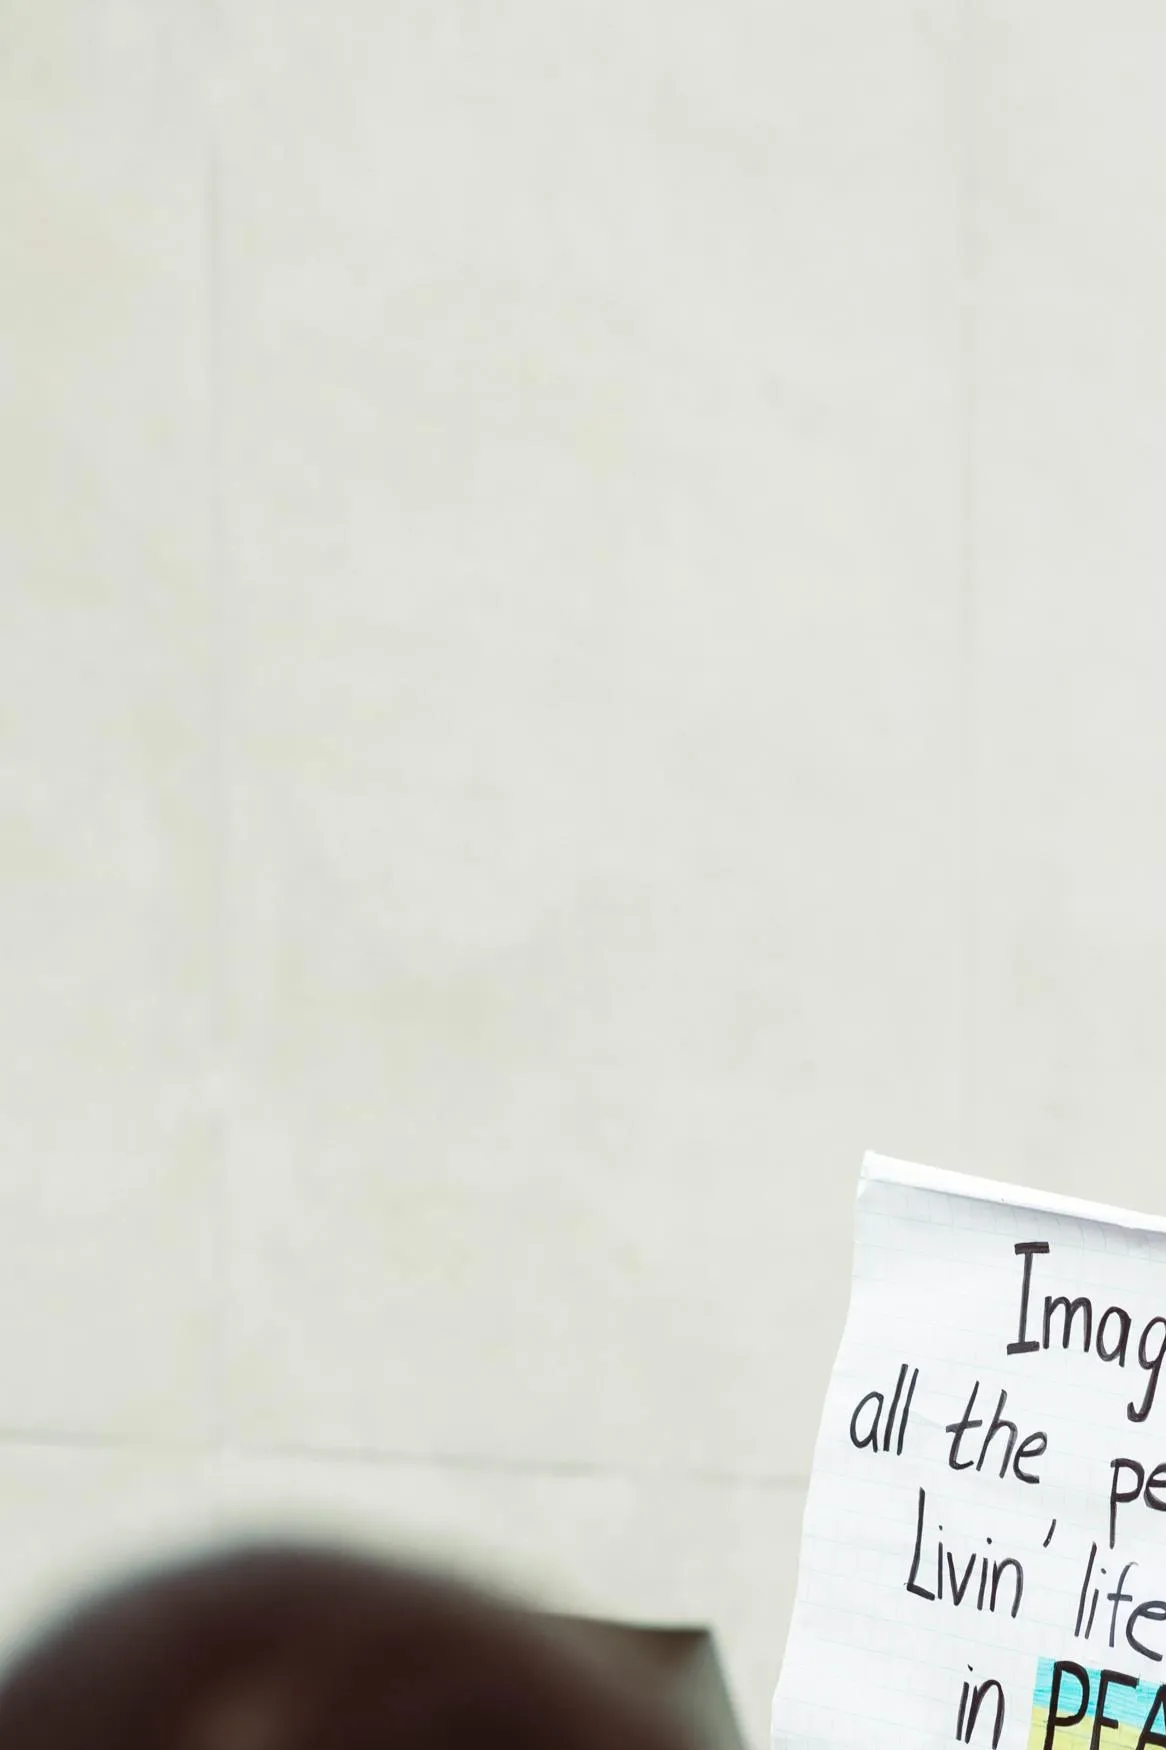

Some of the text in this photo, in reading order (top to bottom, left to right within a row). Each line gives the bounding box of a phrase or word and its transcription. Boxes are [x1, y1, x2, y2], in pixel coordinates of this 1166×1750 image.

[849, 1363, 919, 1456] all
[946, 1381, 1048, 1484] the
[906, 1487, 1057, 1619] Livin'
[956, 1663, 1005, 1750] in
